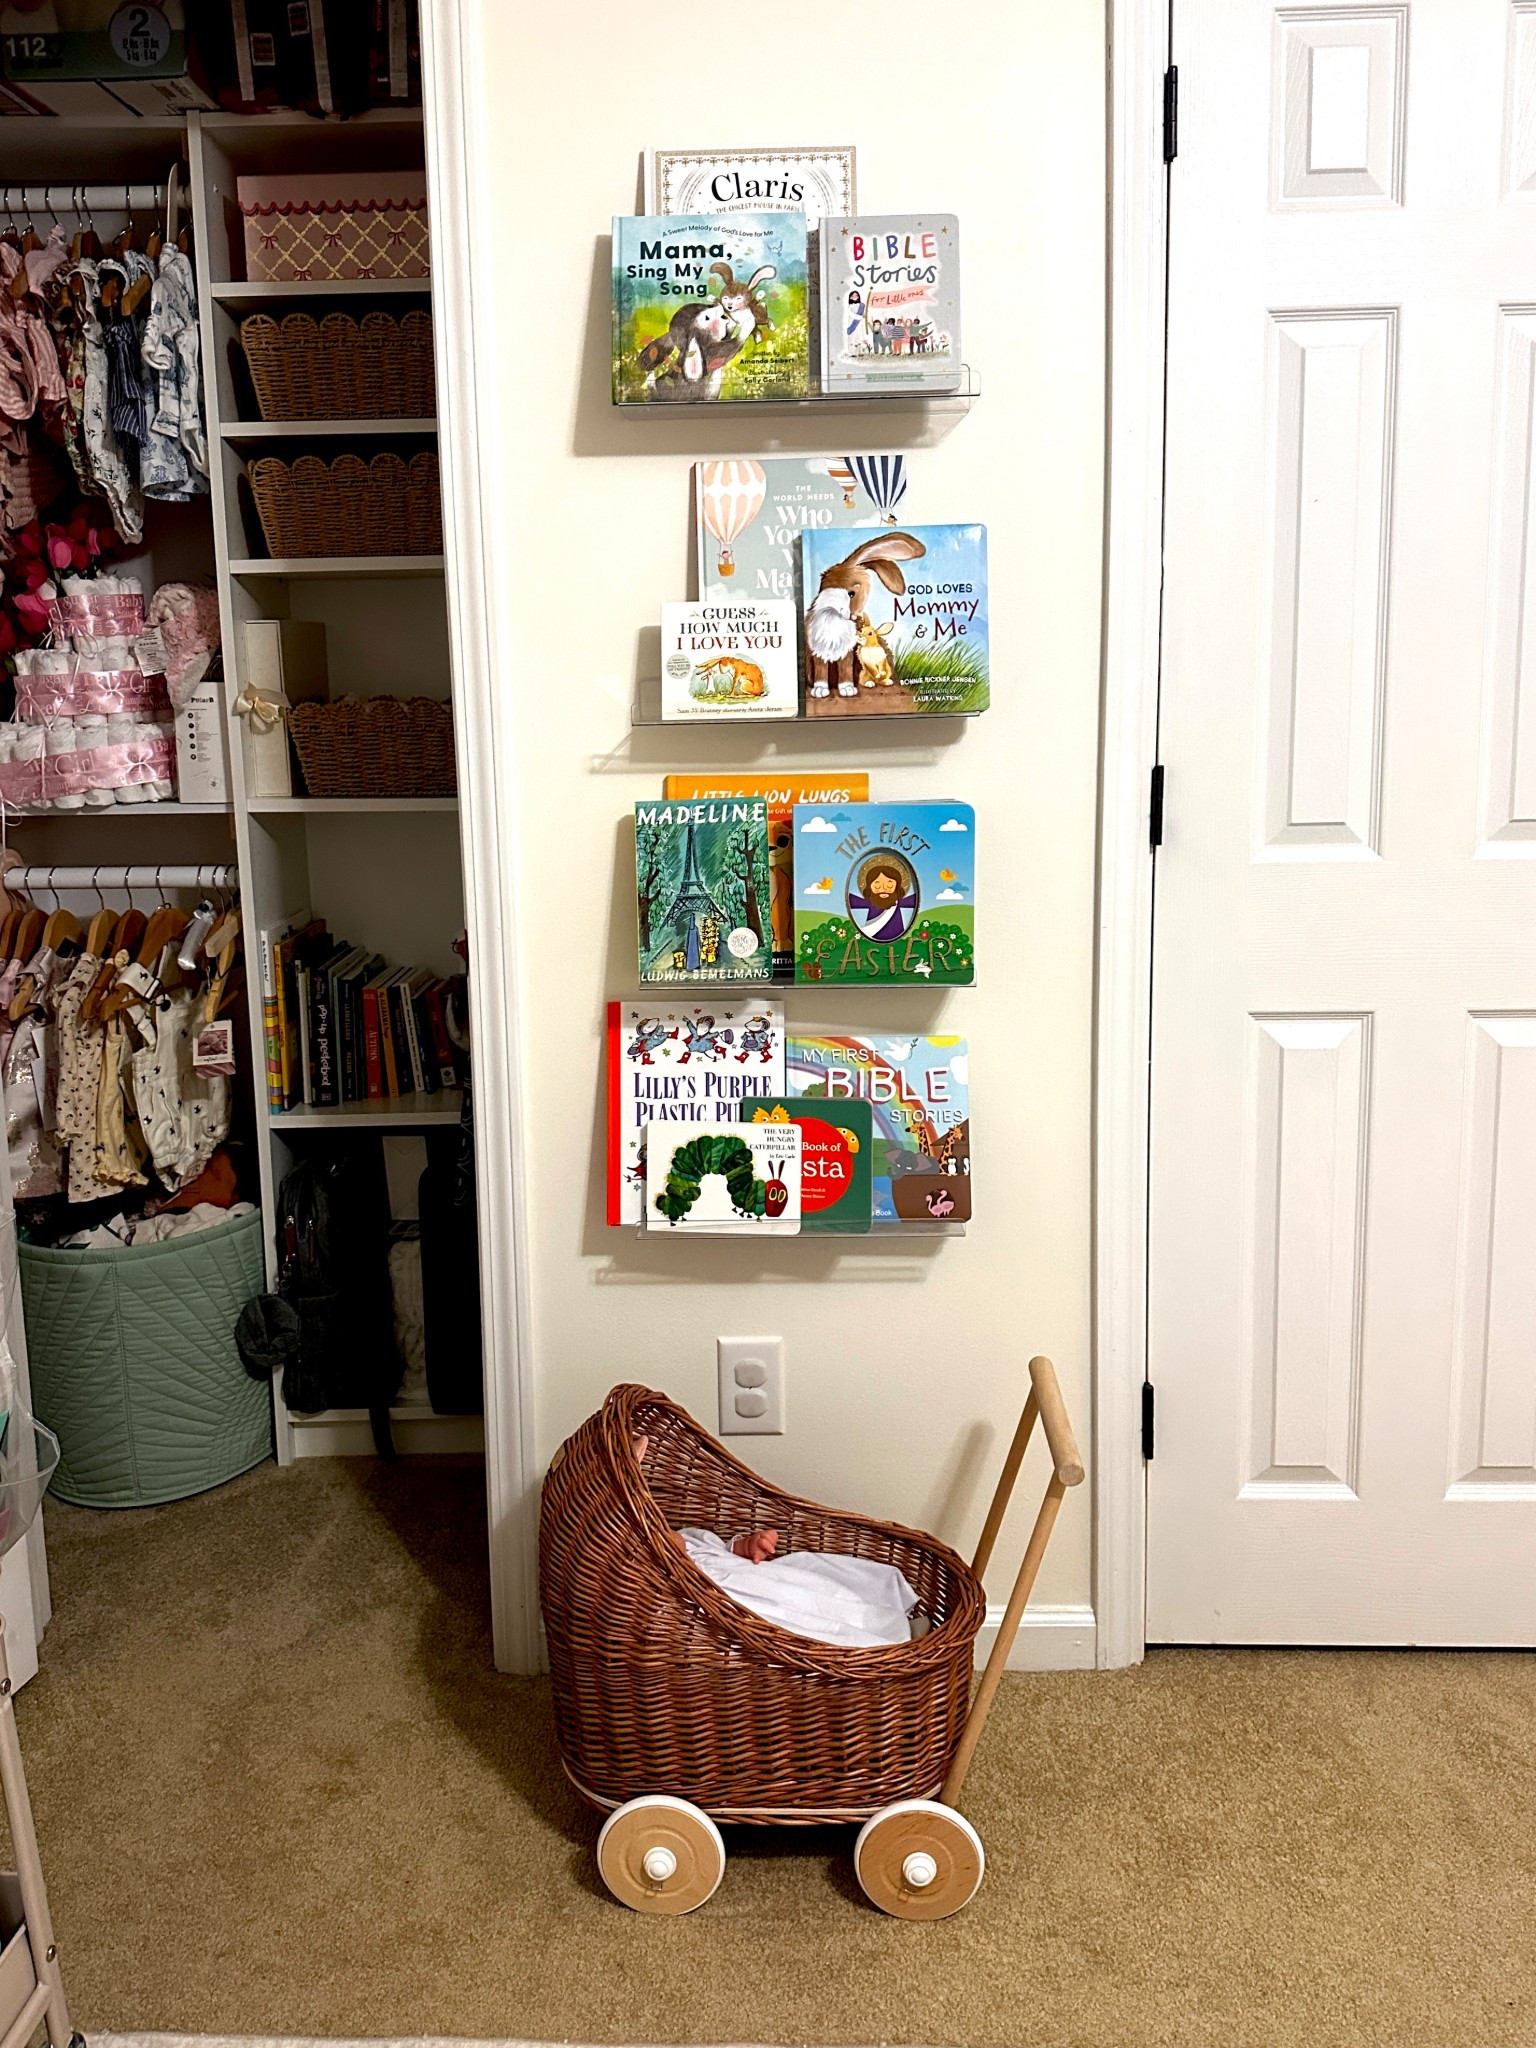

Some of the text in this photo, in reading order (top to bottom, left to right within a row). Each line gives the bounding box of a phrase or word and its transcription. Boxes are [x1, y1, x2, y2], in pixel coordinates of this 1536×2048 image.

[129, 8, 150, 37] 2
[6, 37, 47, 58] 112
[711, 172, 804, 202] Claris
[728, 203, 752, 212] CHICEST
[668, 226, 688, 234] Sweet
[721, 227, 738, 235] God's
[640, 241, 732, 260] Mama,
[853, 234, 936, 261] BIBLE
[627, 264, 703, 281] Sing My
[853, 265, 937, 287] Stories
[660, 282, 707, 297] Song
[871, 295, 885, 306] for
[908, 290, 924, 298] ones
[776, 505, 833, 529] Who
[908, 583, 973, 595] GOD LOVES
[703, 607, 756, 620] GUESS
[894, 597, 979, 621] Mommy
[680, 621, 779, 634] HOW MUCH
[916, 617, 968, 641] & Me
[677, 636, 782, 650] I LOVE YOU
[900, 677, 924, 686] BONNIE
[798, 789, 851, 804] LUNGS
[637, 803, 765, 825] MADELINE
[834, 822, 930, 860] THE FIRST
[641, 968, 769, 981] LUDWIG BEMELMANS
[317, 1005, 327, 1034] pop-up
[802, 1048, 878, 1063] MY FIRST
[633, 1071, 772, 1099] LILLY'S PURPLE
[825, 1067, 951, 1104] BIBLE
[890, 1109, 964, 1123] STORIES
[802, 1142, 841, 1152] Book of
[801, 1156, 845, 1178] sta
